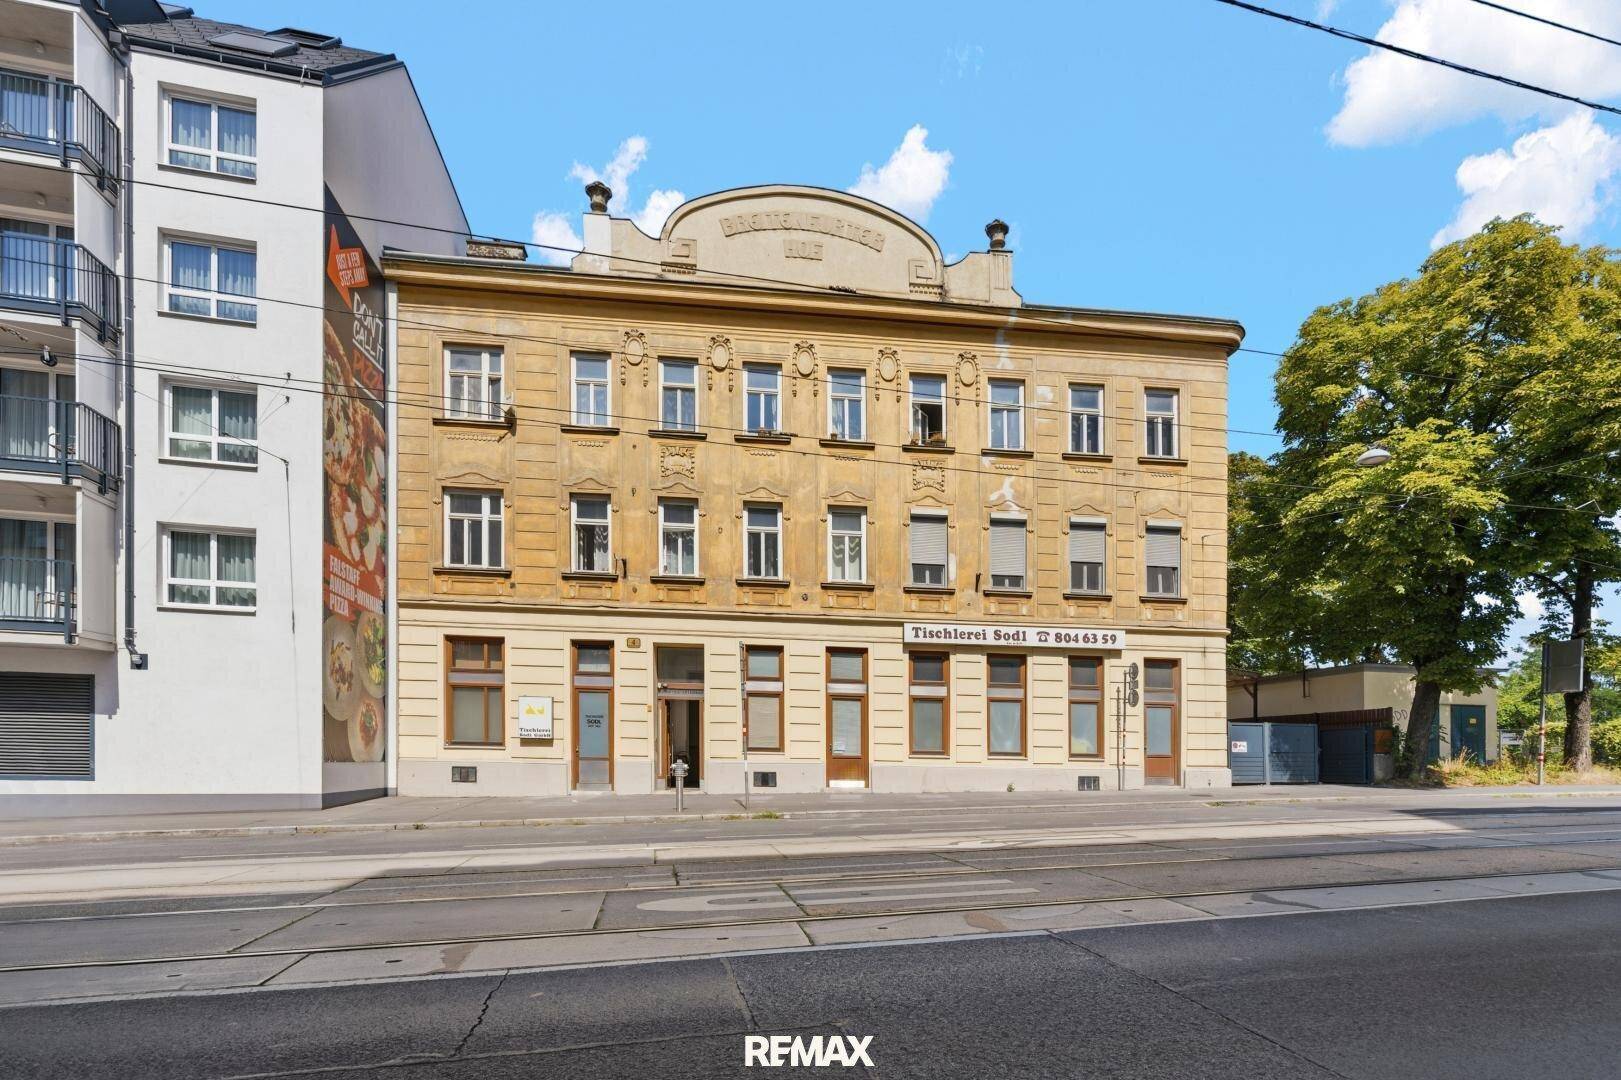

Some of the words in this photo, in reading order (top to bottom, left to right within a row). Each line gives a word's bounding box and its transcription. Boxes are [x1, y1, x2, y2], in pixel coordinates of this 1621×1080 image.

[353, 291, 384, 344] DON'T
[353, 320, 376, 356] CALL
[376, 343, 384, 366] IT
[329, 554, 361, 586] FALSTAFF
[329, 592, 349, 617] PIZZA
[912, 626, 987, 641] Tischlerei
[993, 630, 1028, 642] Sodl
[1054, 632, 1080, 644] 804
[1082, 633, 1098, 644] 63
[1101, 633, 1117, 645] 59
